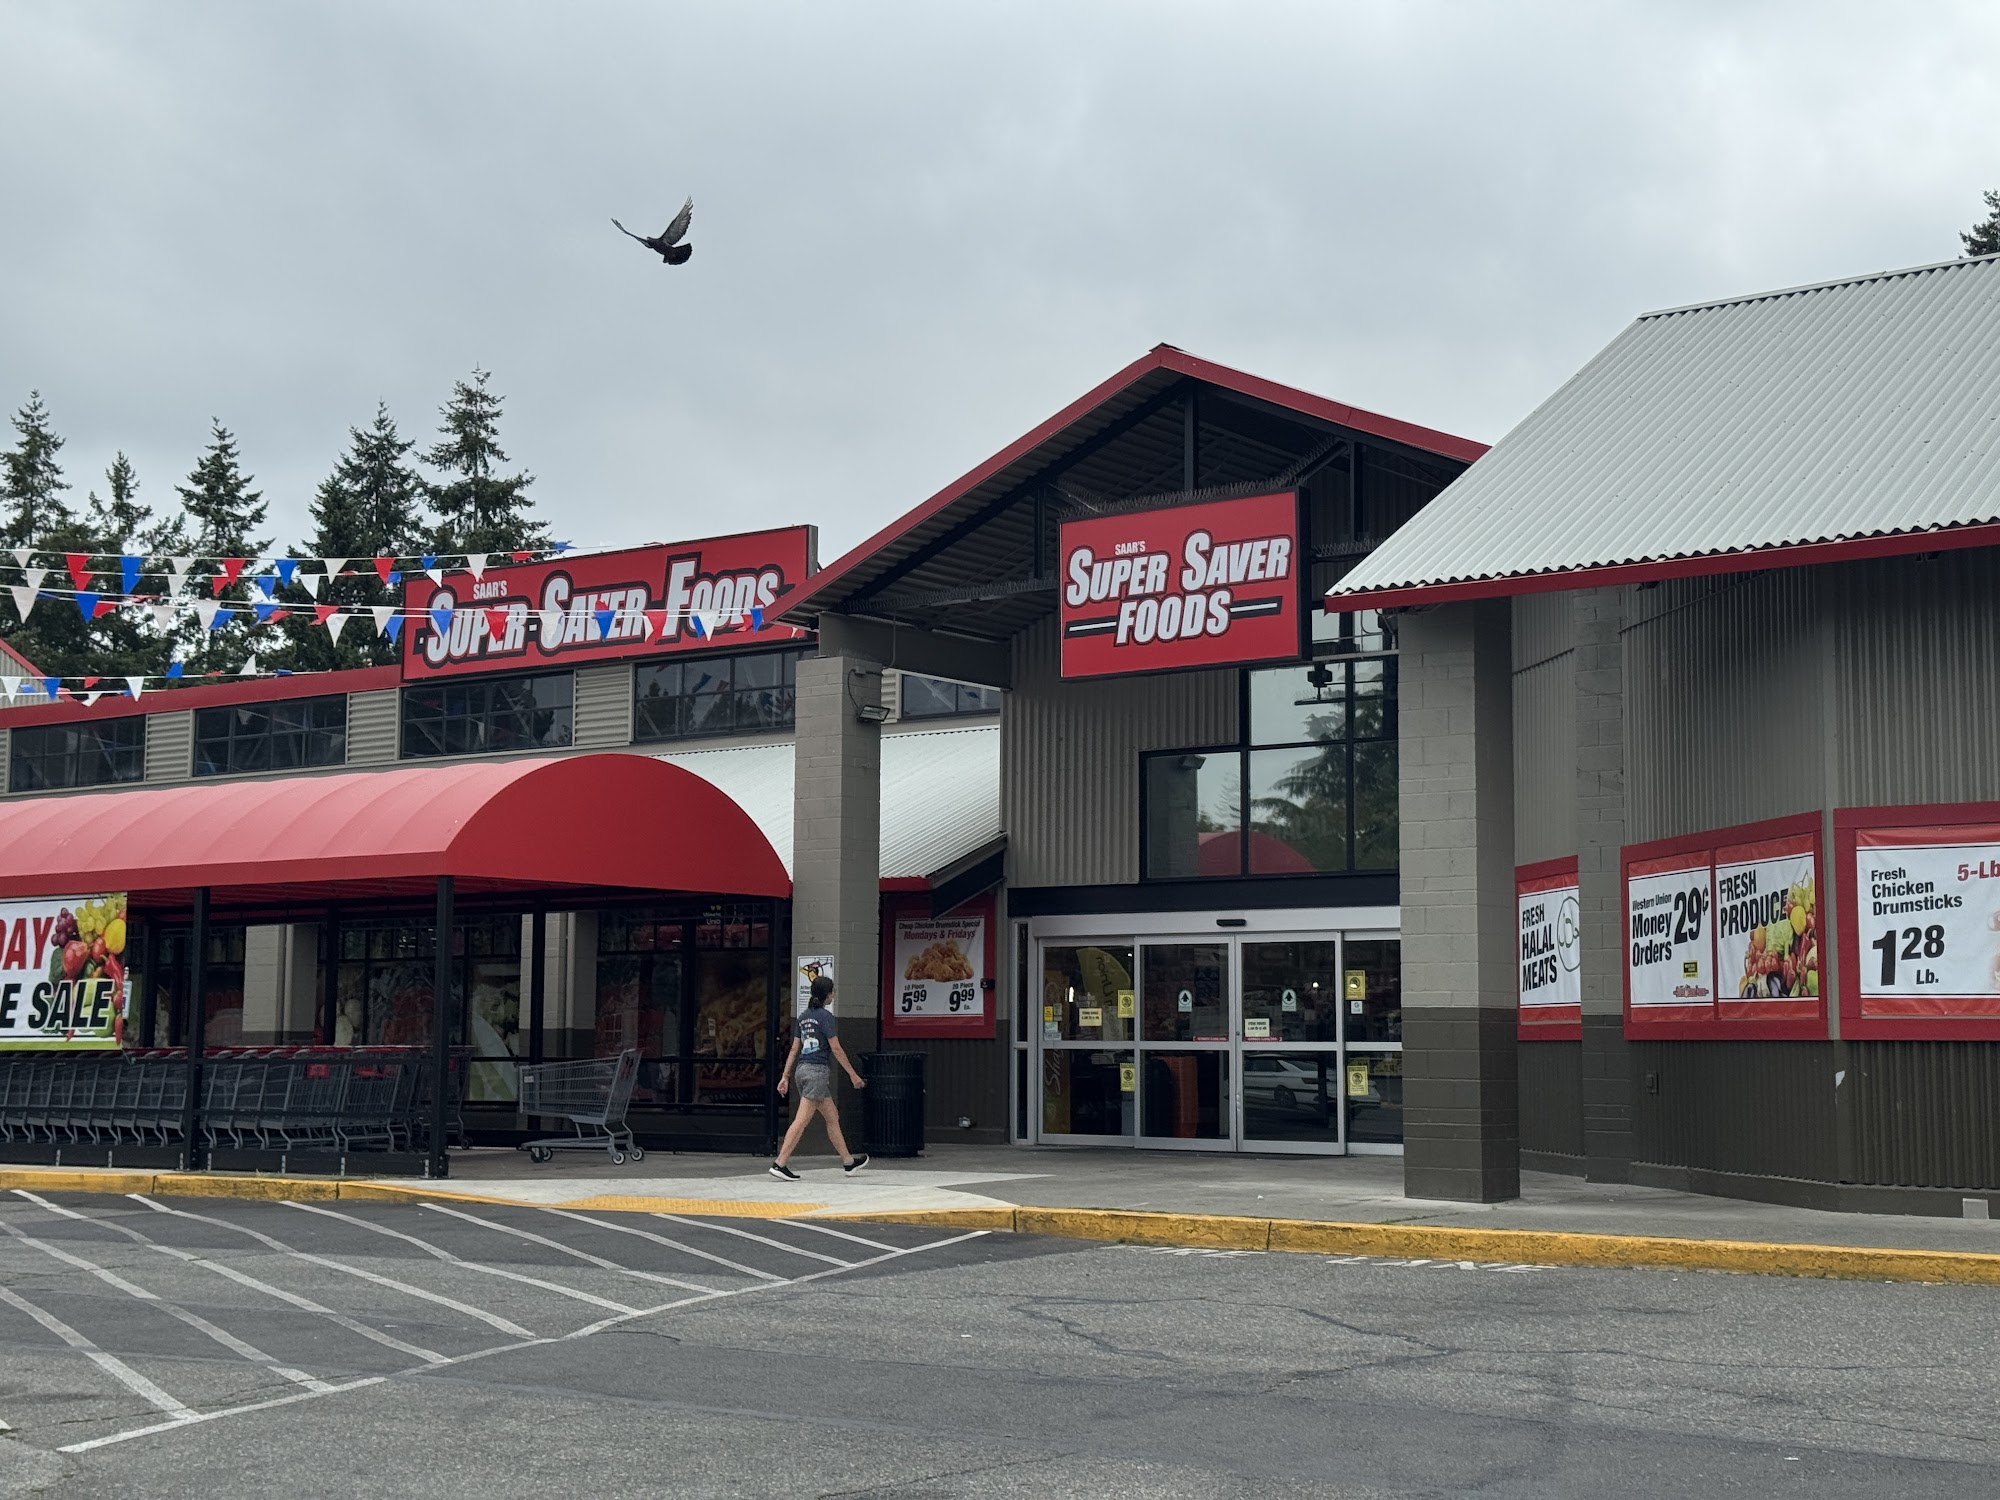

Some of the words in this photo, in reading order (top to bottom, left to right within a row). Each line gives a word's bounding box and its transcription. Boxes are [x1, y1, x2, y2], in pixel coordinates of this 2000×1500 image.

[1114, 541, 1146, 556] SAAR'S
[1066, 548, 1169, 606] SUPER
[1181, 532, 1291, 591] SAVER
[472, 580, 508, 601] SAAR'S
[1114, 590, 1231, 644] FOODS
[1719, 869, 1757, 905] FRESH
[1871, 867, 1907, 882] Fresh
[1632, 898, 1655, 912] Western
[1655, 893, 1672, 906] Union
[1871, 881, 1935, 899] Chicken
[1522, 903, 1545, 930] FRESH
[1720, 887, 1789, 939] PRODUCE
[1872, 894, 1963, 916] Drumsticks
[904, 931, 937, 941] Mondays
[940, 930, 946, 938] &
[948, 929, 976, 940] Fridays
[914, 921, 935, 930] Chicken
[935, 920, 962, 929] Drumstick
[962, 920, 981, 929] Special
[1632, 912, 1673, 940] Money
[1522, 923, 1555, 962] HALAL
[1632, 939, 1672, 968] Orders
[1522, 954, 1558, 993] MEATS
[1916, 968, 1940, 985] Lb.
[28, 981, 114, 1030] SALE
